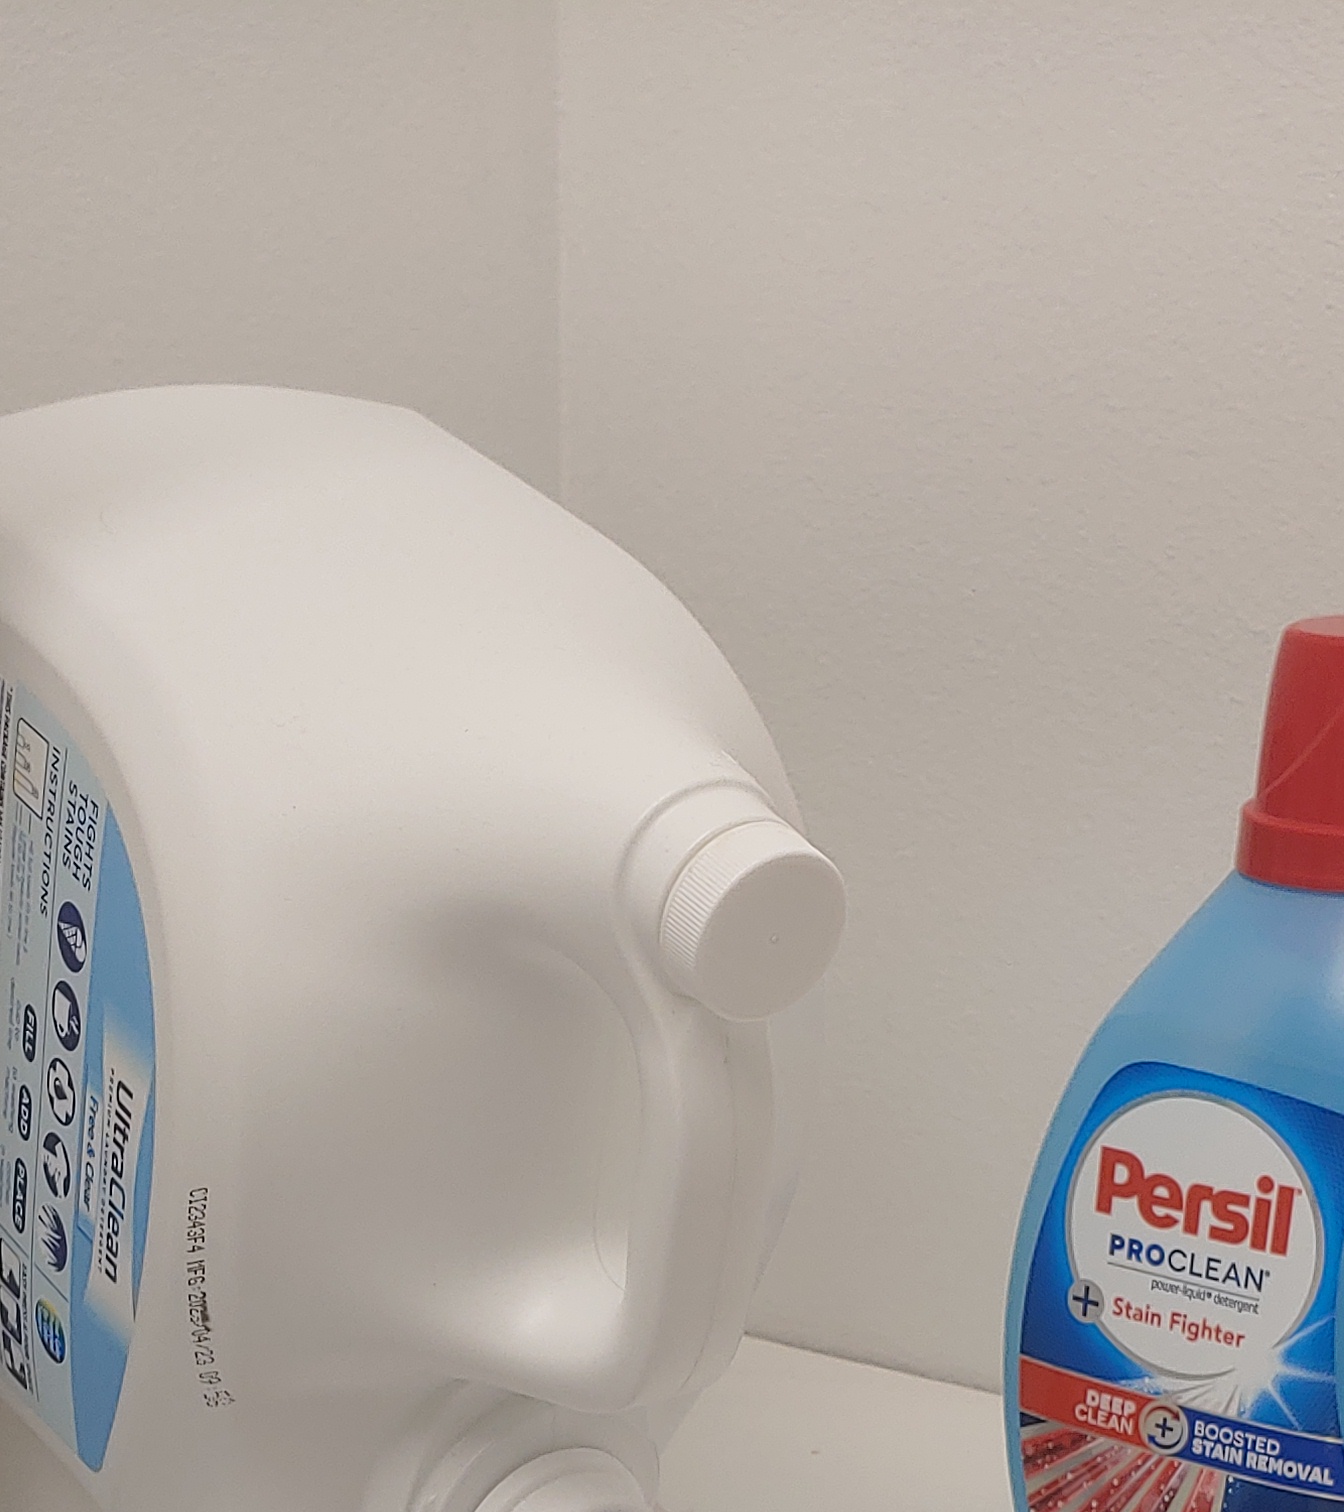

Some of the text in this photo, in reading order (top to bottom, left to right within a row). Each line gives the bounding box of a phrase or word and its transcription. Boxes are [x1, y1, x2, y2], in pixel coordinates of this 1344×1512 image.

[39, 746, 61, 918] INSTRUCTIONS
[62, 781, 78, 869] STAINS
[72, 792, 89, 881] TOUGH
[82, 800, 99, 891] FIGHTS
[24, 1009, 34, 1055] FILL
[20, 1088, 29, 1136] ADD
[83, 1095, 99, 1212] Free & Clear
[104, 1081, 134, 1284] UltraClean
[15, 1163, 25, 1230] PLACE
[1094, 1145, 1296, 1257] Persil
[1112, 1297, 1245, 1348] Stain Fighter
[1213, 1293, 1259, 1315] detergent
[1074, 1405, 1134, 1436] CLEAN
[1085, 1389, 1137, 1416] DEEP
[1191, 1439, 1335, 1487] STAIN REMOVAL
[1193, 1420, 1281, 1457] BOOSTED
